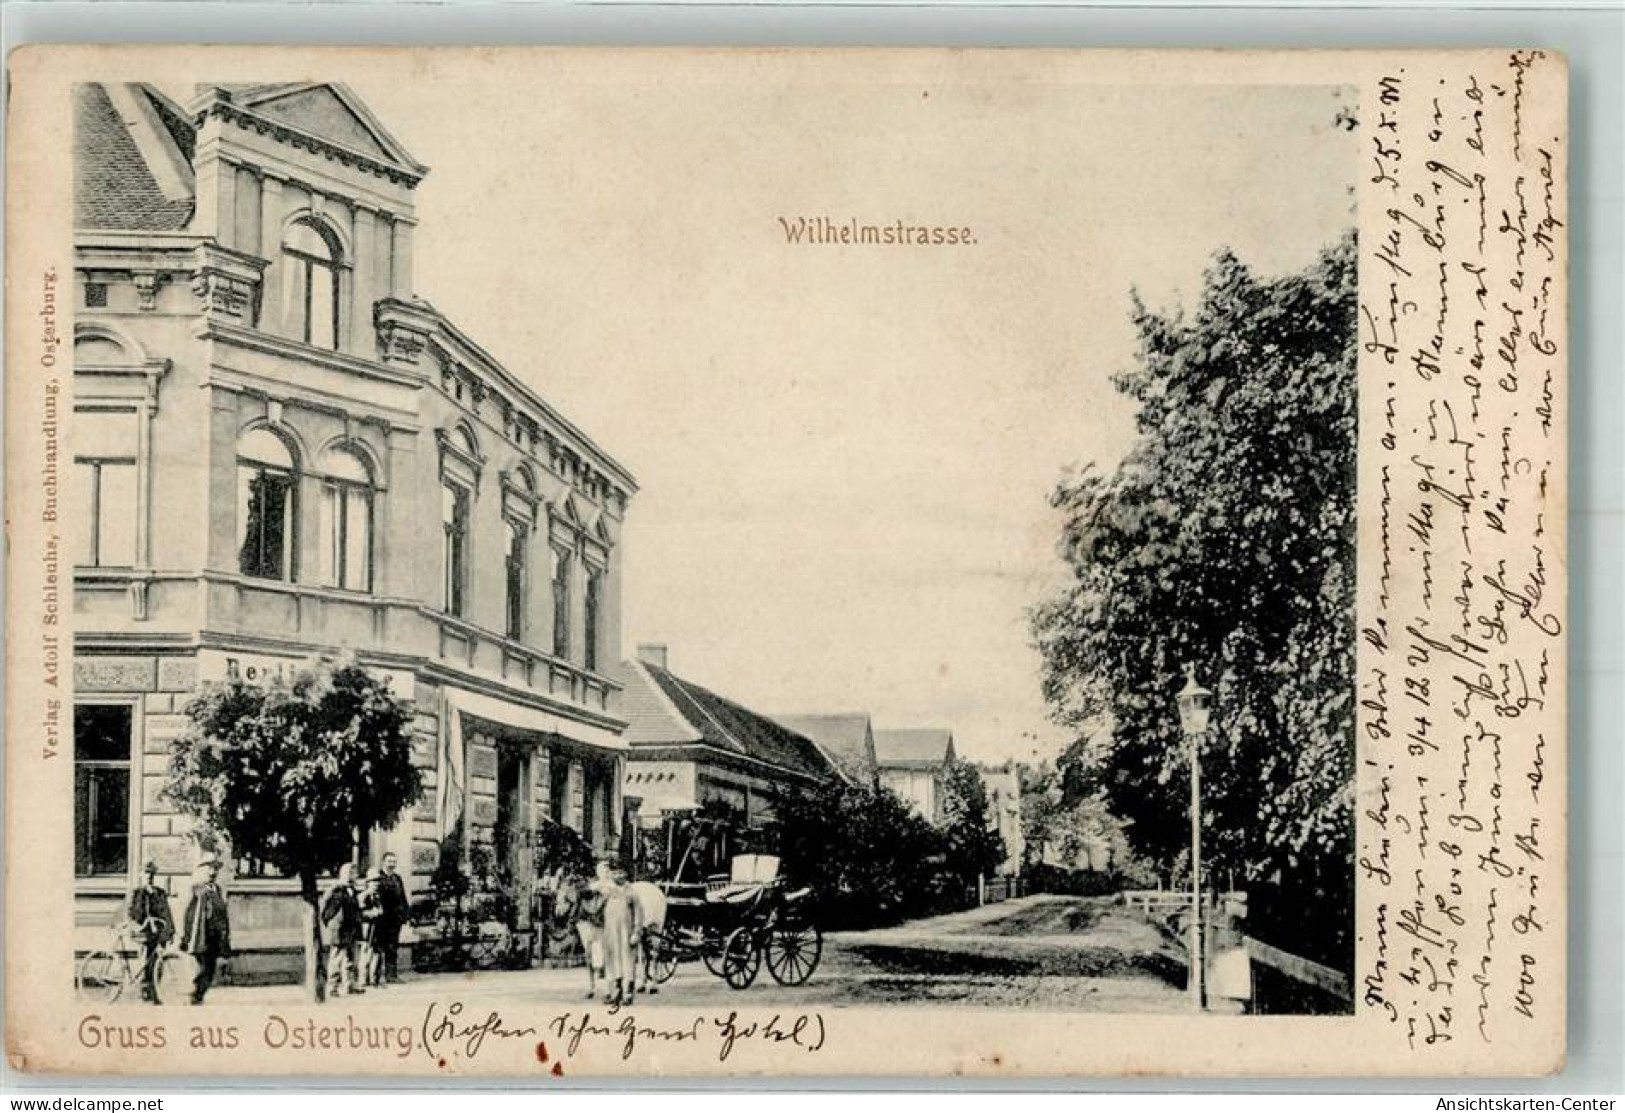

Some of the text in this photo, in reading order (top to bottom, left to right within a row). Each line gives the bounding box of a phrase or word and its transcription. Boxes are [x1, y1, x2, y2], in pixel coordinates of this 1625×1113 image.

[777, 216, 979, 245] Wilhelmstrasse.
[39, 266, 58, 368] Osterburg.
[41, 379, 60, 522] Buchhandlung,
[42, 634, 59, 688] Adolf
[1404, 677, 1430, 707] 12
[43, 700, 60, 759] Verlag
[78, 1014, 423, 1057] Gruss aus Osterburg.
